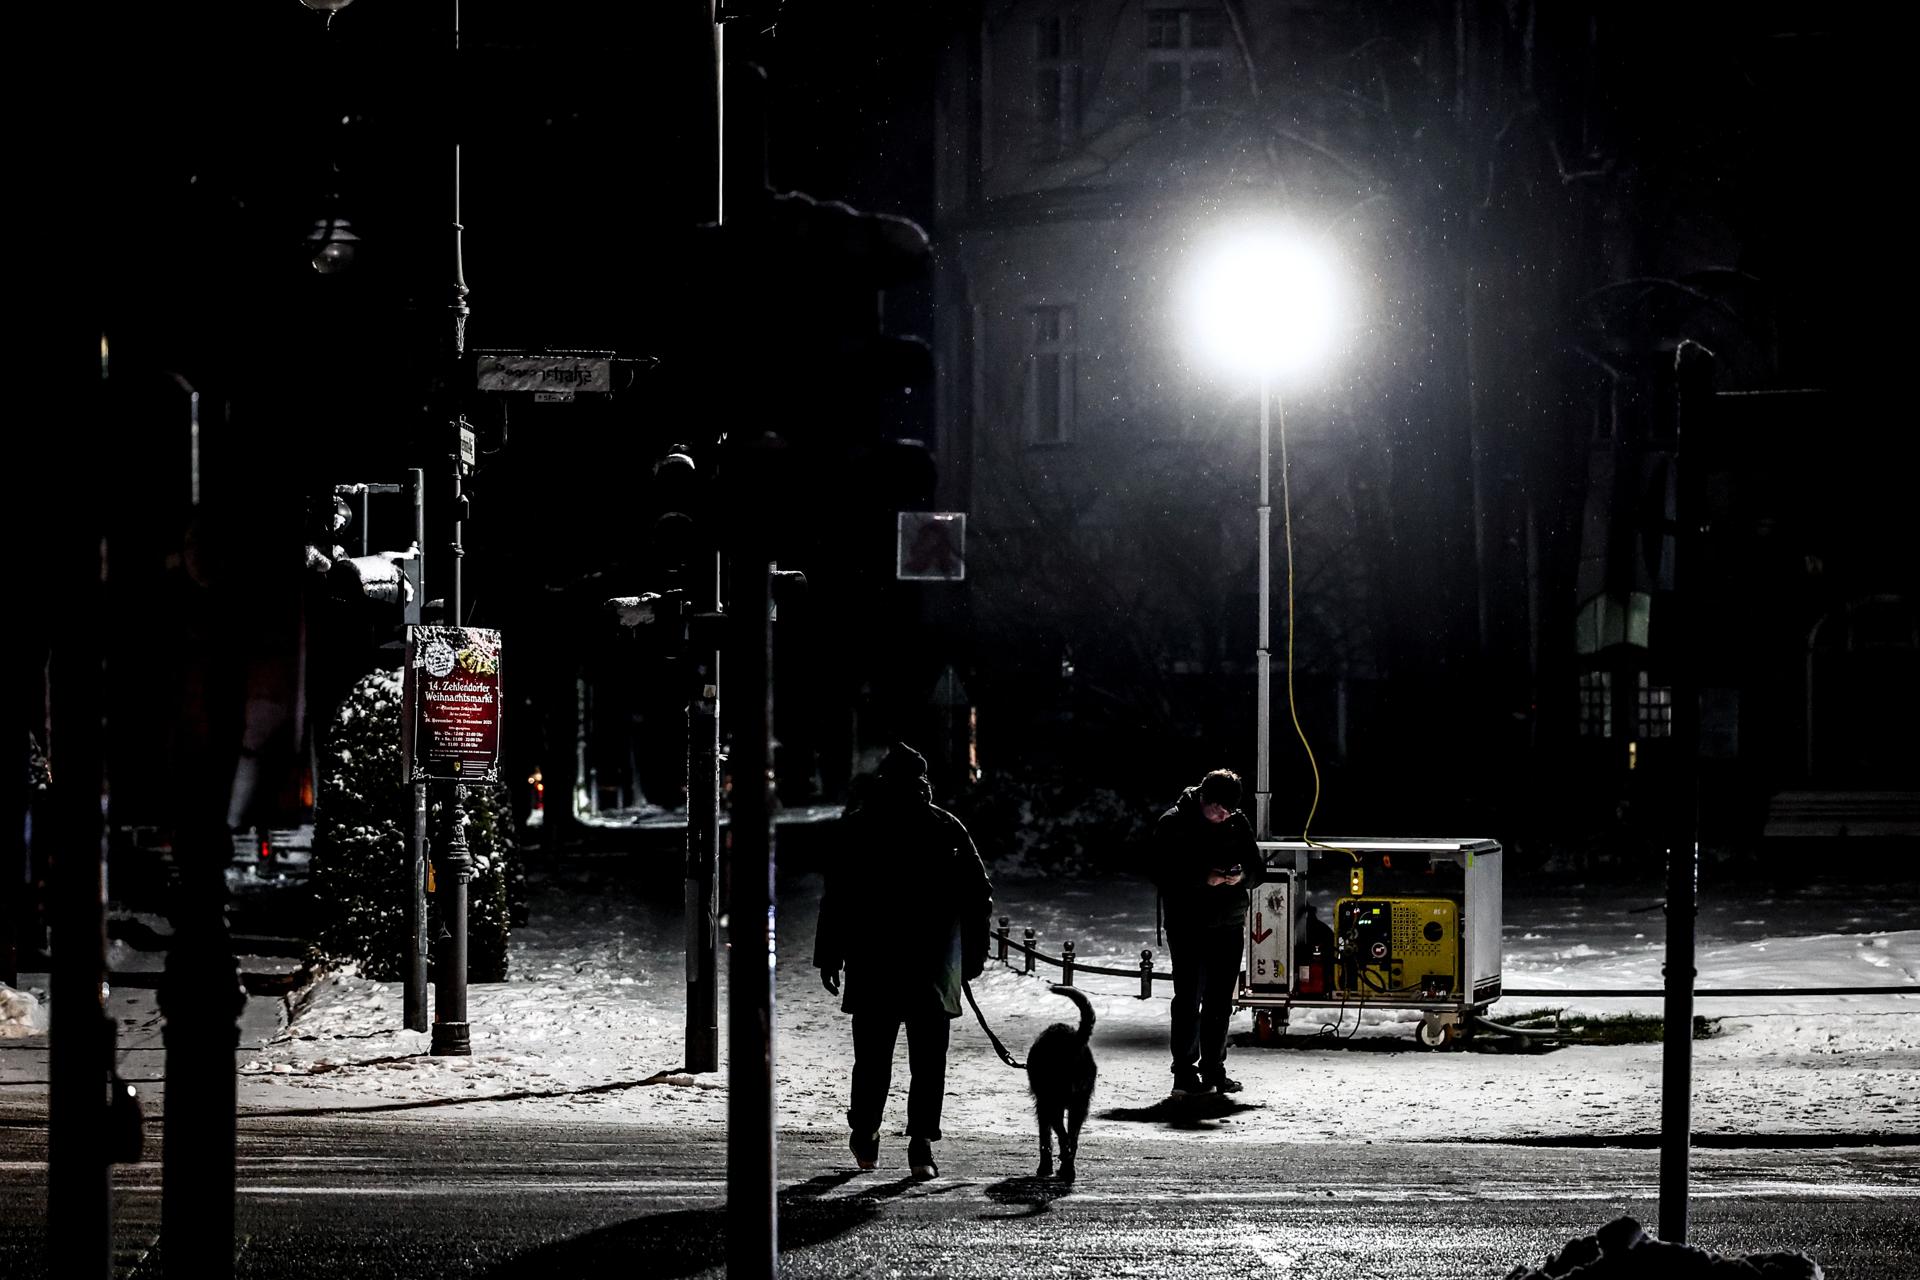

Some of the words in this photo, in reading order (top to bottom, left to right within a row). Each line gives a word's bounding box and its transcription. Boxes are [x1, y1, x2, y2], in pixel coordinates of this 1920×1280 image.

[428, 681, 441, 691] 14.
[442, 681, 490, 692] Zehlendorfer
[425, 691, 493, 703] Weihnachtsmarkt
[1257, 959, 1266, 975] 2.0
